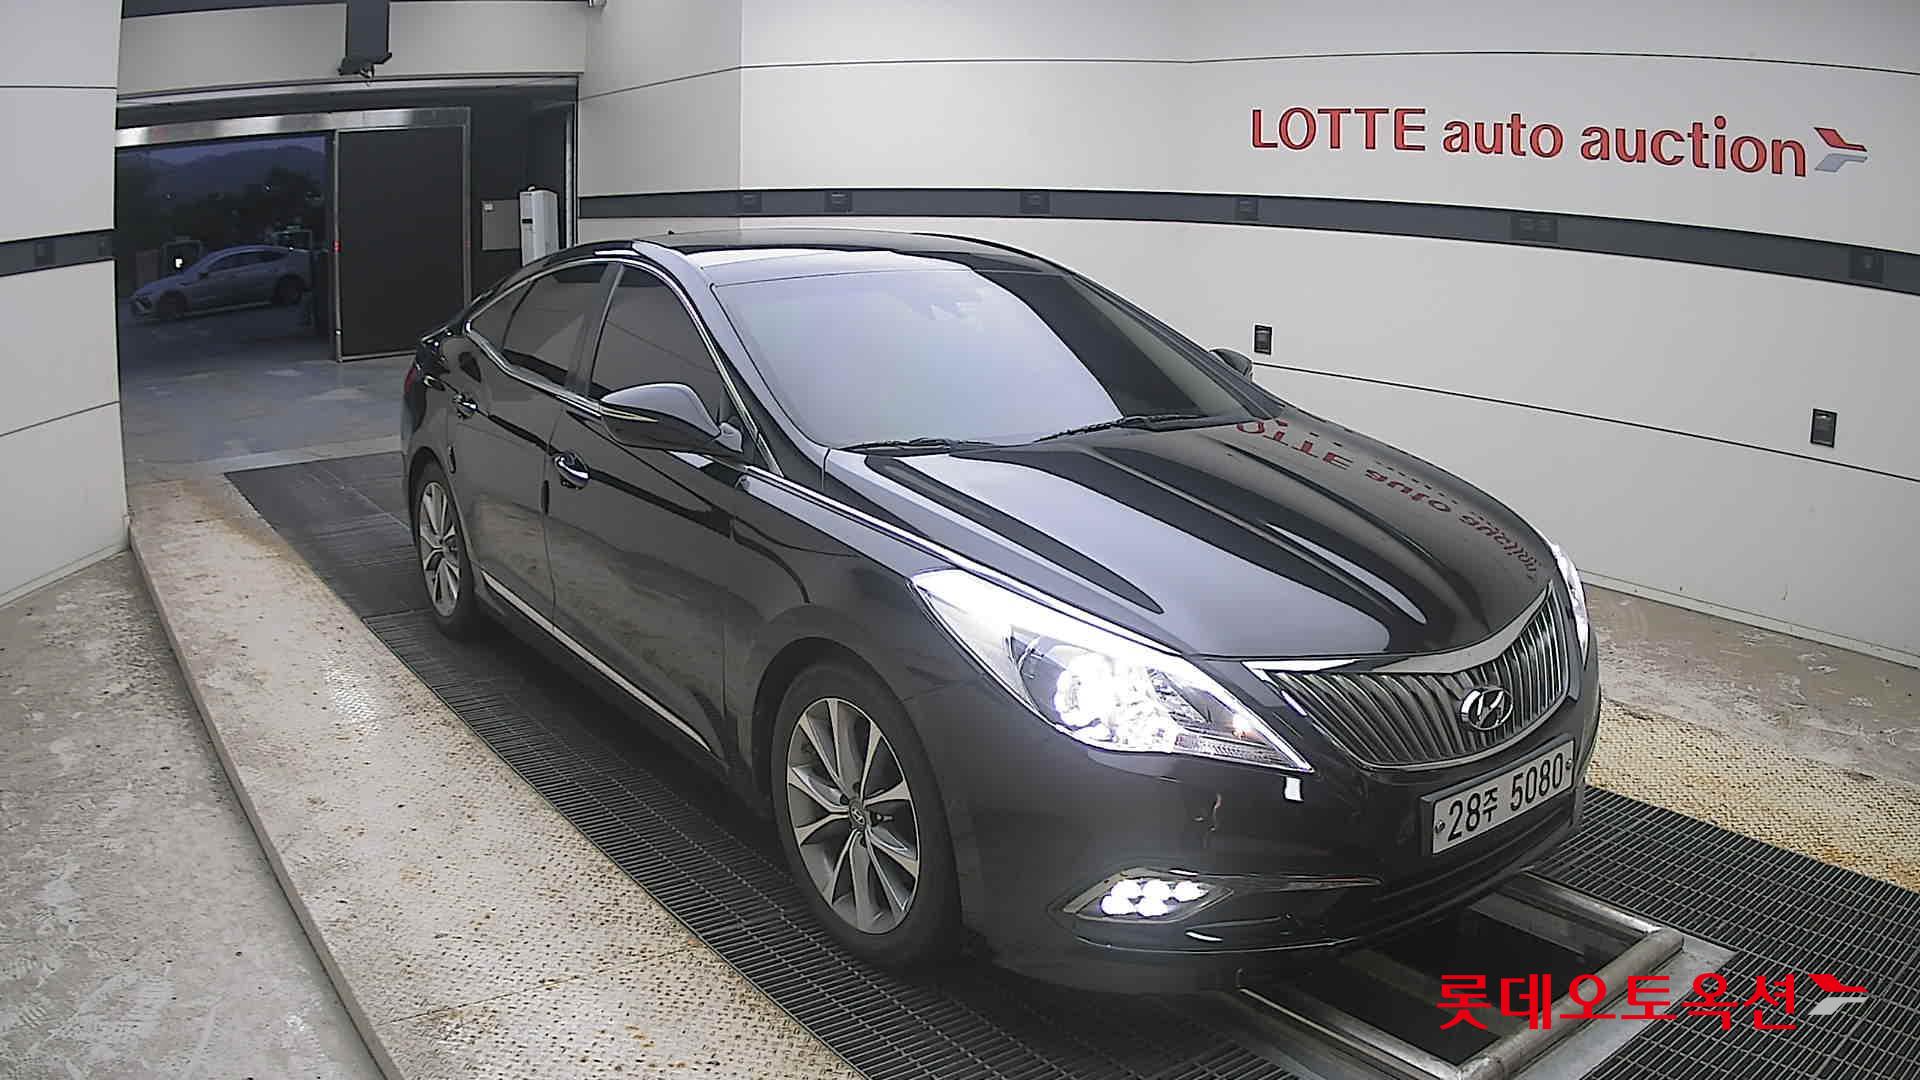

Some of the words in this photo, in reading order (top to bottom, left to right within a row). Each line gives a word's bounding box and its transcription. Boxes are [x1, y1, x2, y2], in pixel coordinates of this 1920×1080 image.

[1252, 107, 1426, 152] LOTTE
[1442, 113, 1564, 159] auto
[1580, 115, 1807, 178] auction
[1447, 787, 1499, 842] 28주
[1510, 752, 1564, 812] 5080
